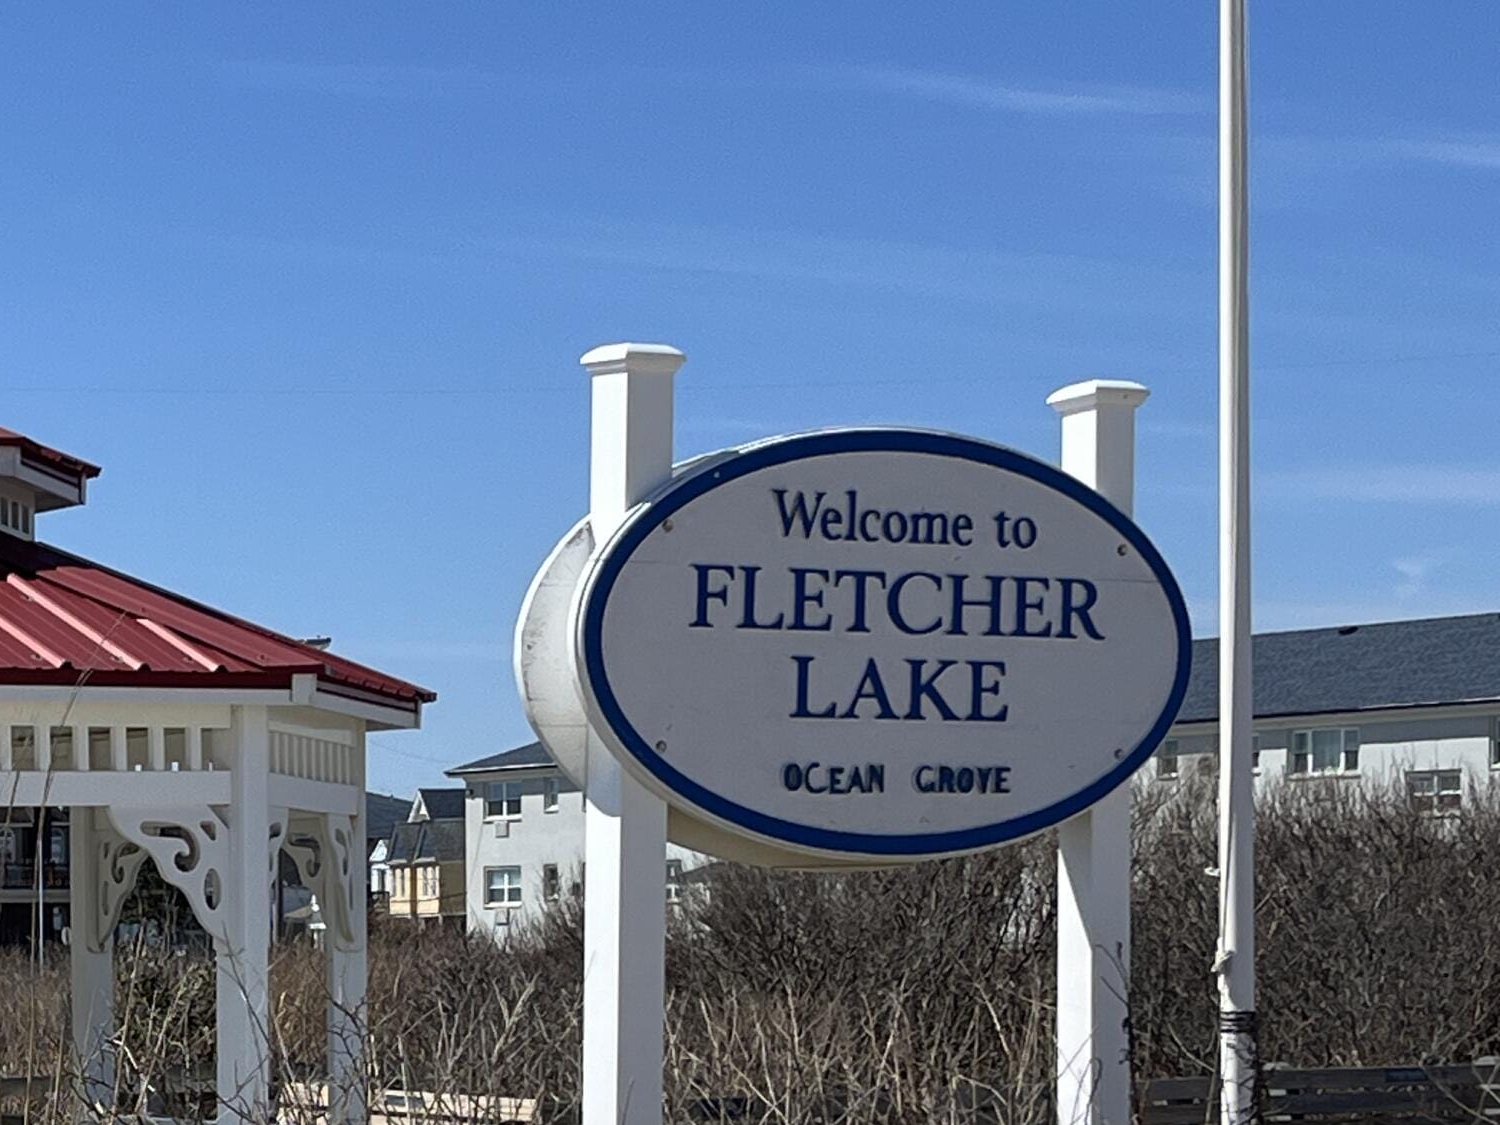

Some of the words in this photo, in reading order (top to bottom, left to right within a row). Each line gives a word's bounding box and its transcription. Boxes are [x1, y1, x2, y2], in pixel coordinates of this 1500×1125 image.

[771, 487, 974, 547] Welcome
[993, 510, 1038, 549] to
[689, 563, 1106, 641] FLETCHER
[789, 655, 1009, 722] LAKE
[782, 762, 885, 795] OCEAN
[913, 765, 1012, 794] GROVE
